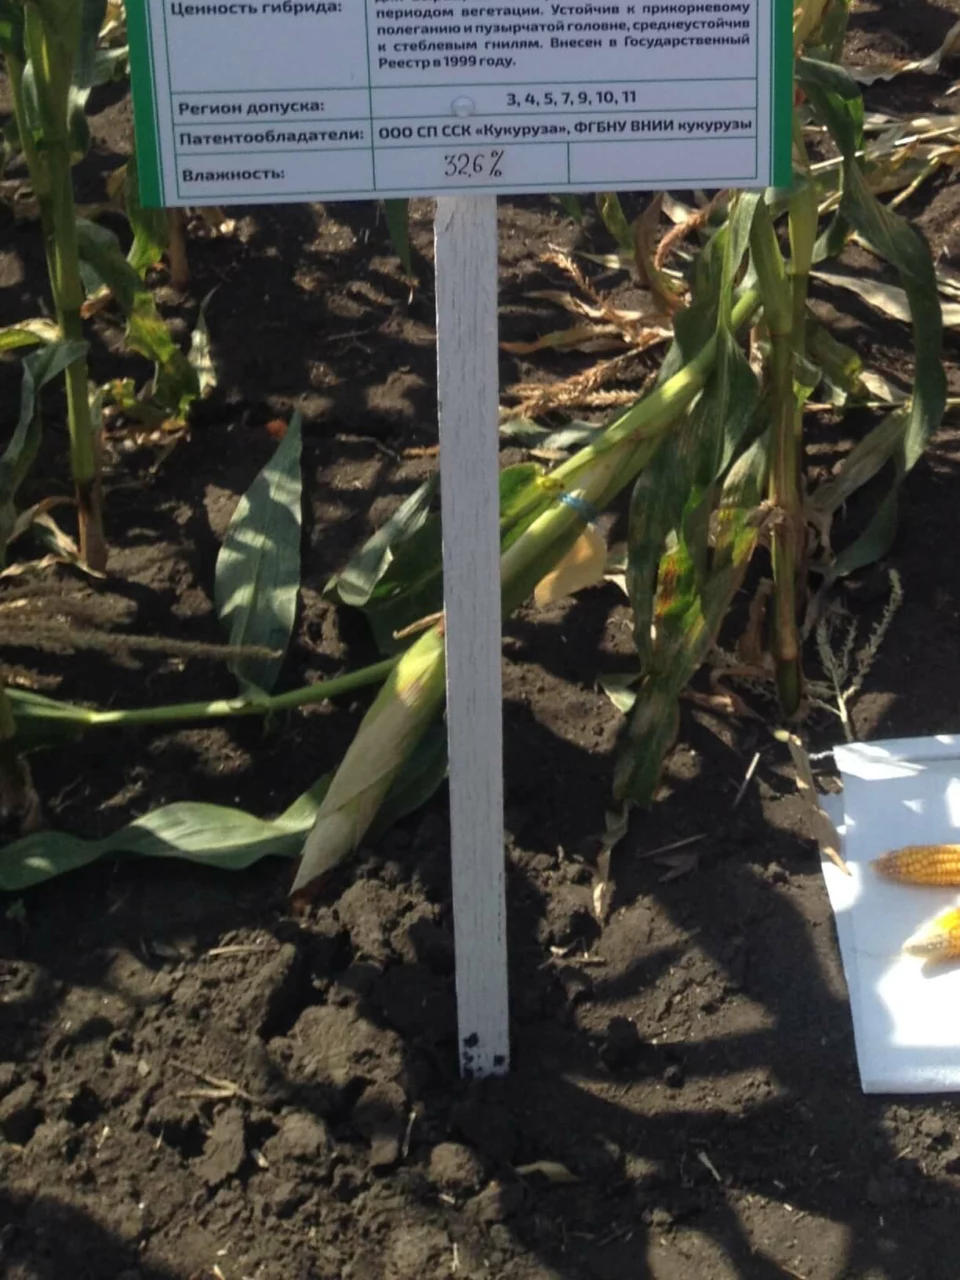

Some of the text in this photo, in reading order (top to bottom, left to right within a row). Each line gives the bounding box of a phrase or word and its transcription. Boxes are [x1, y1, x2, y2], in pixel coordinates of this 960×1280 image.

[170, 0, 343, 17] Ценность гибрида:
[376, 3, 751, 21] периодом вегетации. Устойчив к прикорневому
[377, 18, 750, 37] полеганию и пузырчатой головне, среднеустойчив
[378, 34, 750, 53] к стеблевым гнилям. Внесен в Государственный
[378, 55, 516, 71] Реестр в 1999 году.
[506, 90, 637, 108] 3, 4, 5, 7, 9, 10, 11
[178, 101, 325, 116] Регион допуска:
[179, 128, 364, 146] Патентообладатели:
[378, 119, 753, 139] ООО СП ССК «Кукуруза», ФГБНУ ВНИИ кукурузы
[182, 169, 285, 183] Влажность:
